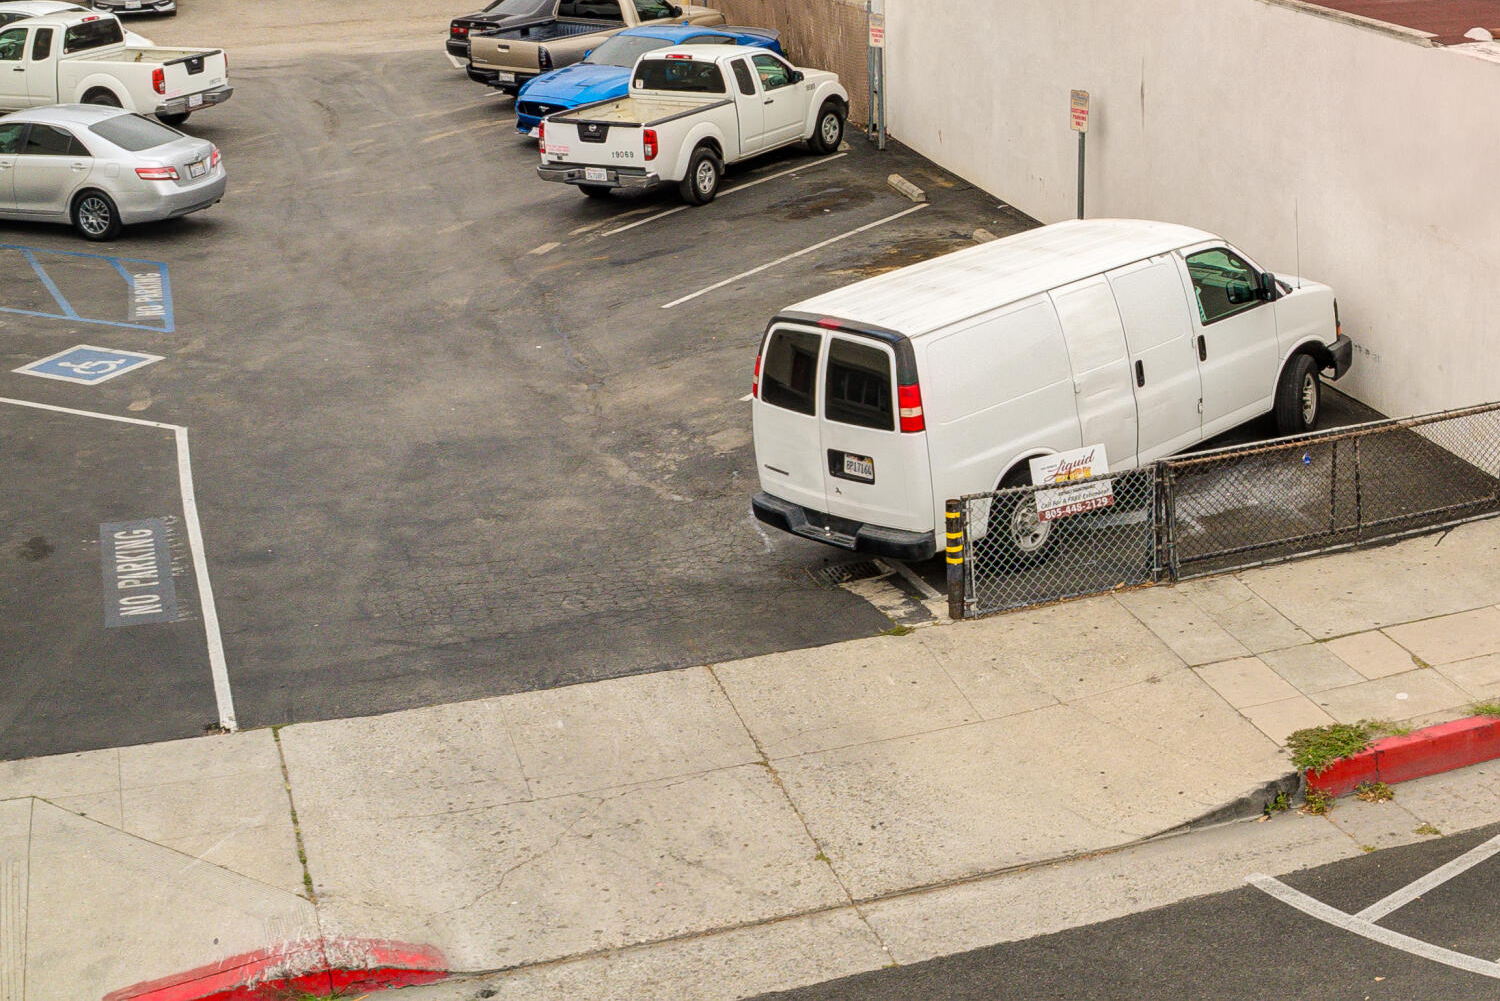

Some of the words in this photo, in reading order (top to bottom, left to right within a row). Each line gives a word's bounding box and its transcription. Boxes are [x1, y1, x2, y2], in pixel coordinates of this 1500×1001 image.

[134, 273, 163, 303] PARKING
[1044, 449, 1095, 482] Liquid
[114, 529, 160, 589] PARKING
[119, 594, 163, 616] NO
